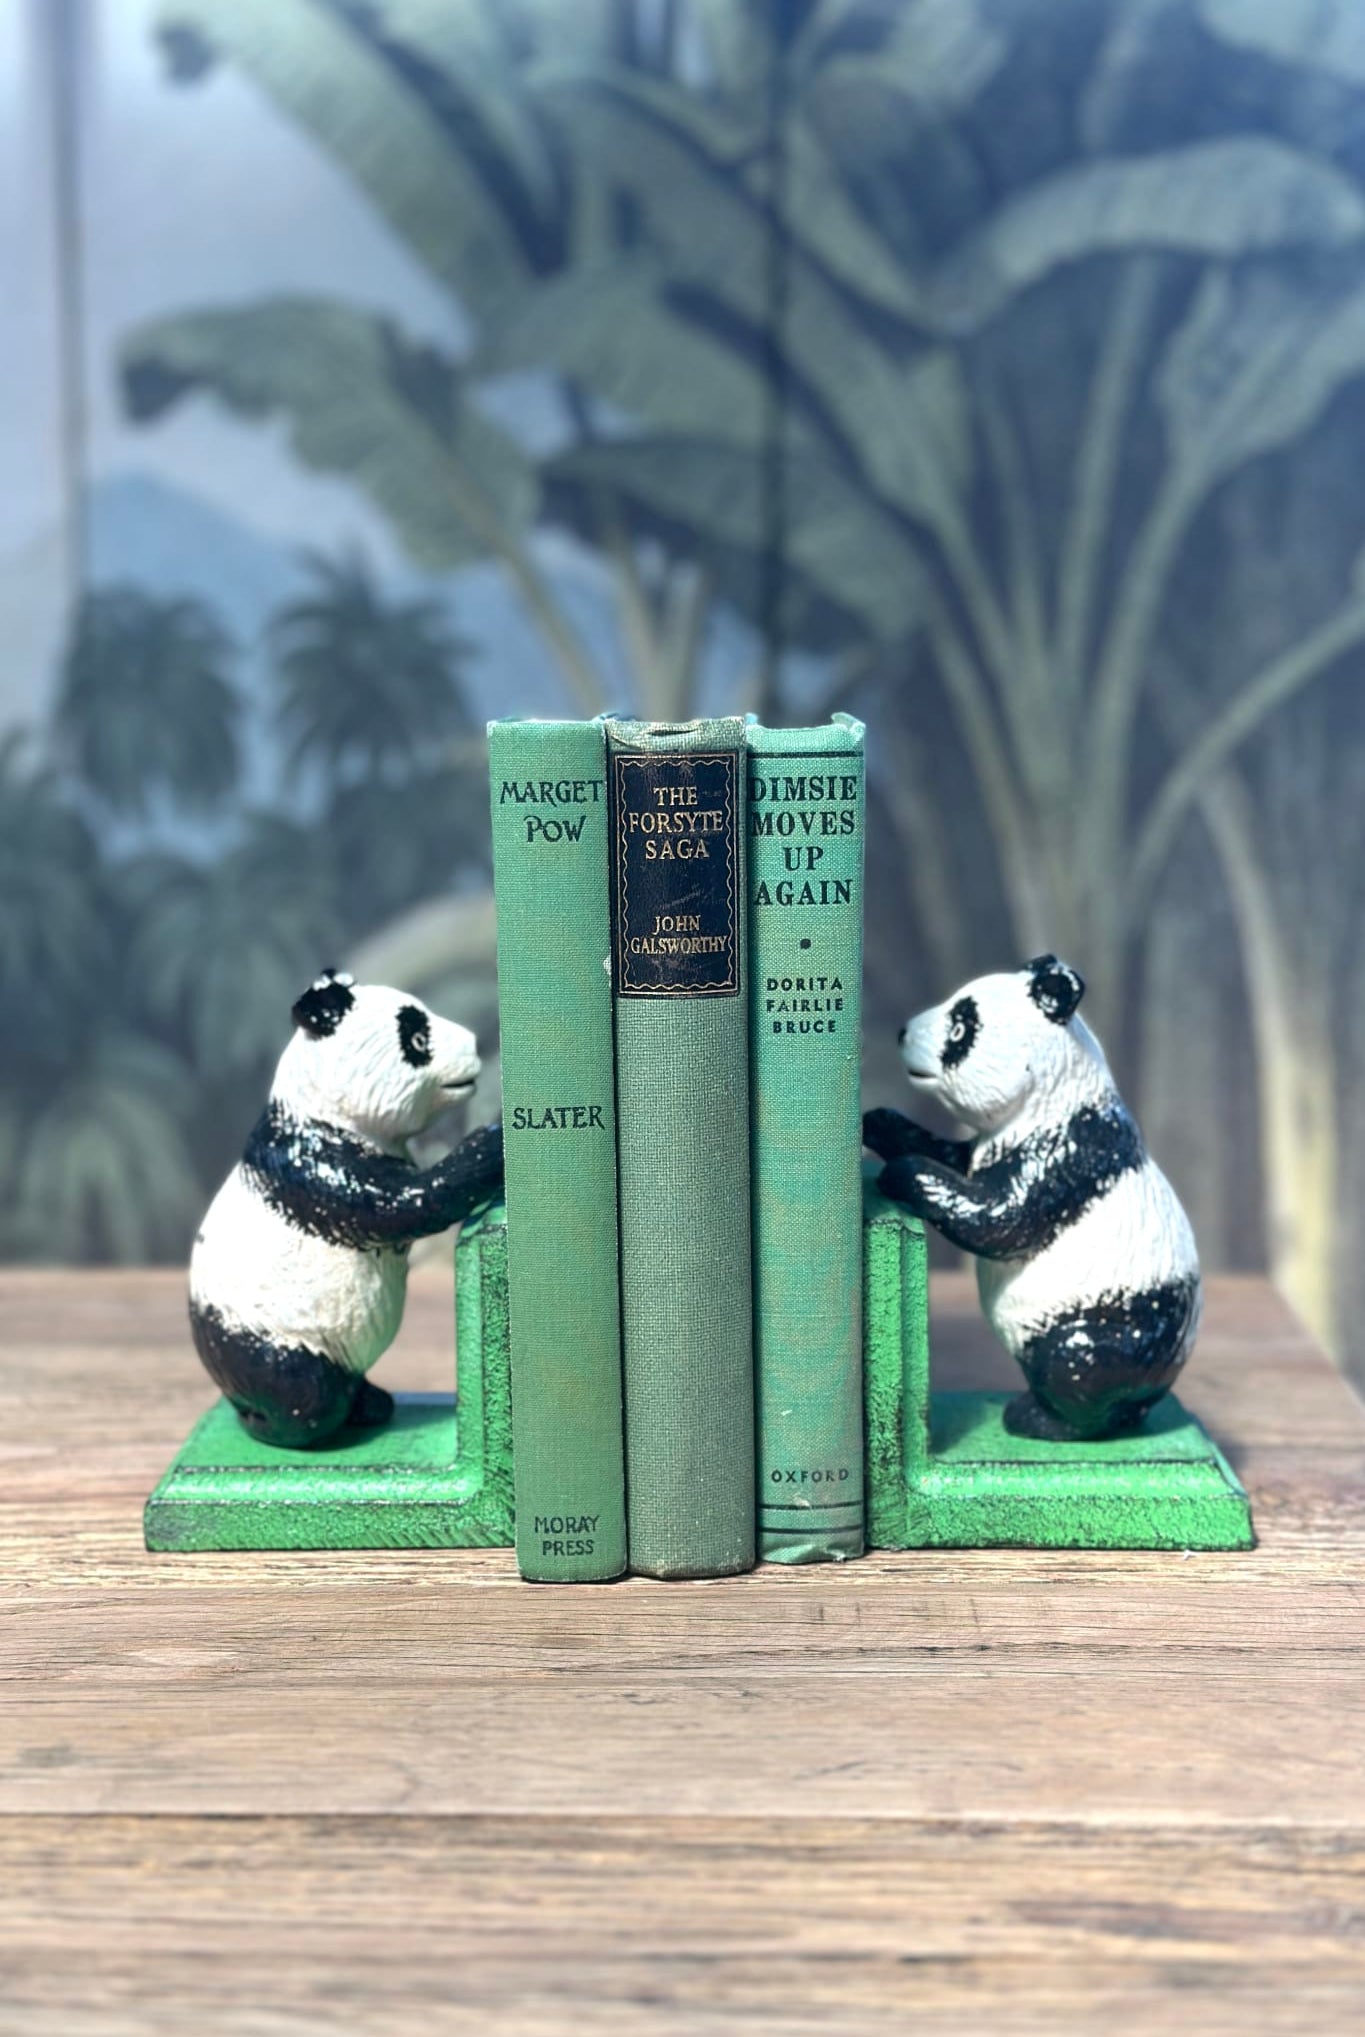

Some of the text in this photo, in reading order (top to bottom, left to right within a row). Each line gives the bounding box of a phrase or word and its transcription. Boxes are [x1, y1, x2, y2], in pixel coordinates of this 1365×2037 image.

[500, 779, 603, 807] MARGET
[653, 786, 698, 806] THE
[751, 776, 858, 802] DIMSIE
[523, 814, 587, 843] POW
[629, 811, 723, 834] FORSYTE
[751, 810, 856, 837] MOVES
[645, 838, 710, 860] SAGA
[783, 846, 824, 872] UP
[754, 879, 854, 906] AGAIN
[652, 914, 701, 936] JOHN
[630, 935, 728, 956] GALSWORTHY
[766, 977, 843, 992] DORITA
[766, 998, 843, 1013] FAIRLIE
[772, 1019, 837, 1034] BRUCE
[511, 1105, 605, 1130] SLATER
[771, 1467, 850, 1484] OXFORD
[534, 1515, 600, 1535] MORAY
[542, 1538, 595, 1557] PRESS
